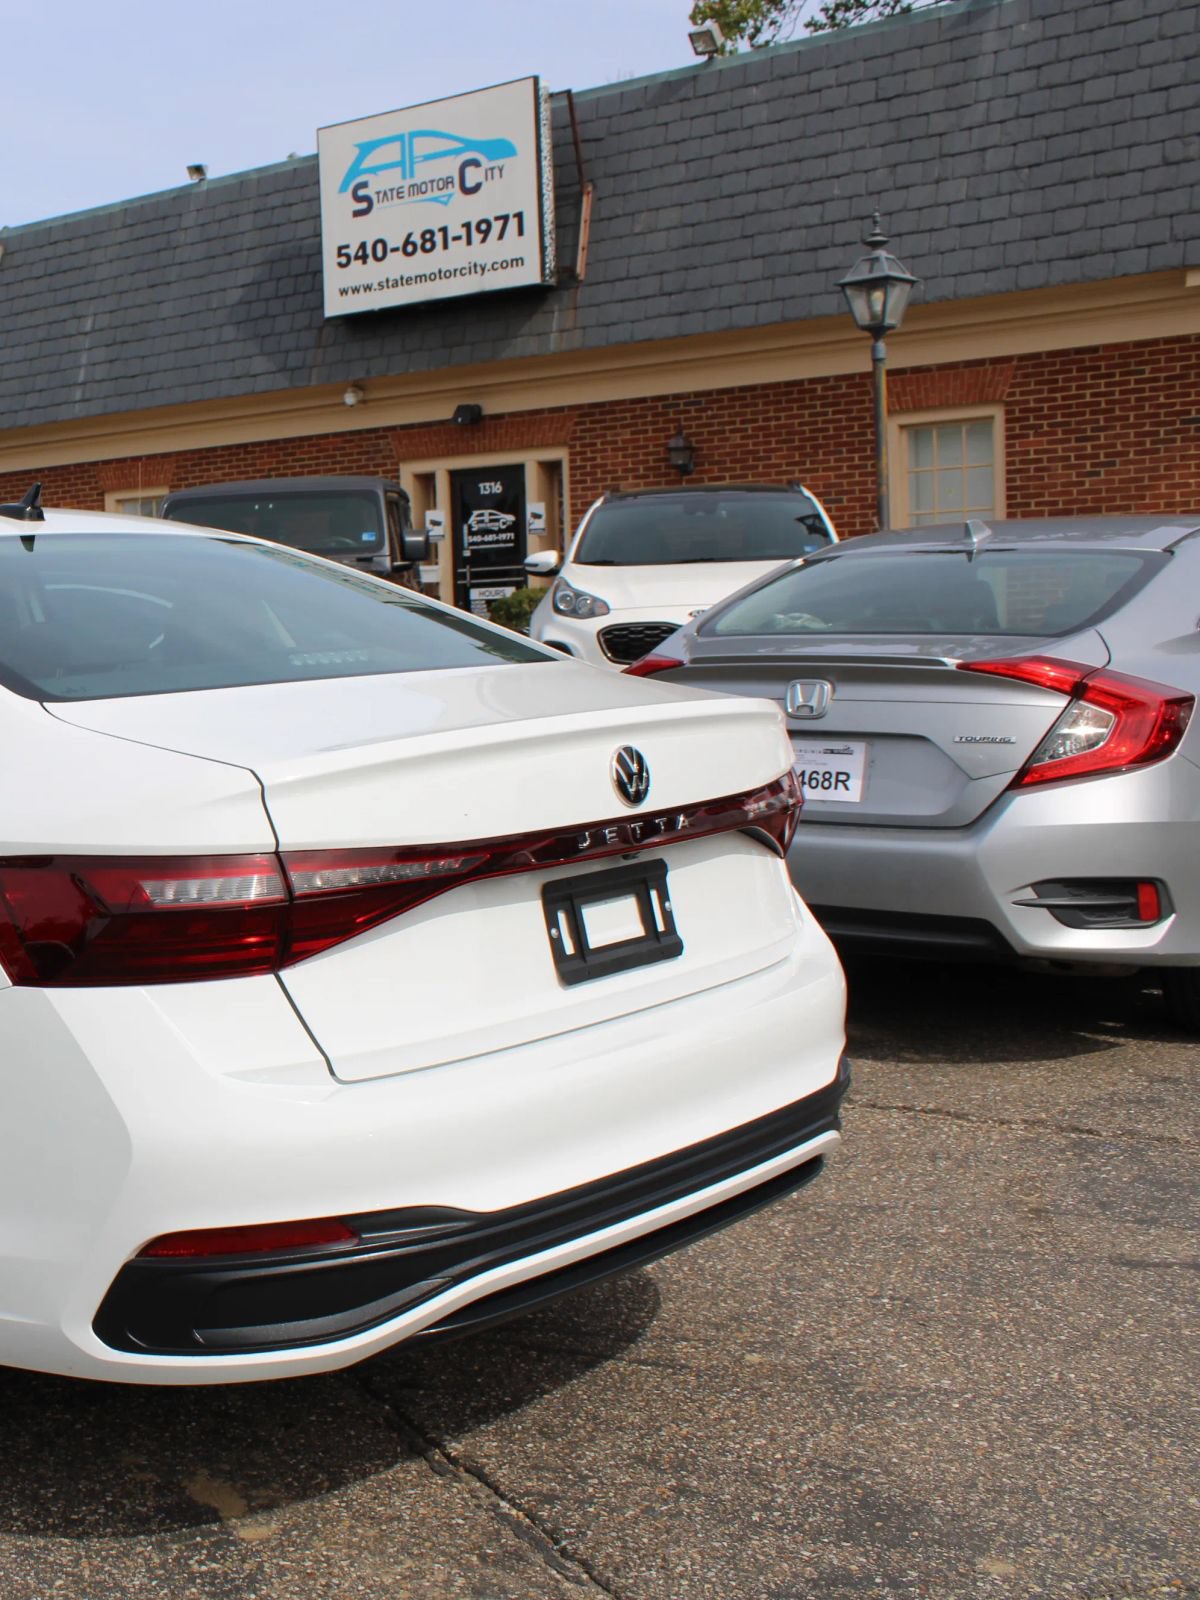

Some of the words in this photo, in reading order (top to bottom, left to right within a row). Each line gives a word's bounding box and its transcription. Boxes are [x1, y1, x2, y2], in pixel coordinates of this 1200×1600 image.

[351, 180, 405, 218] STATE
[407, 176, 455, 198] MOTOR
[458, 157, 505, 195] CITY
[336, 211, 525, 269] 540-681-1971
[338, 256, 525, 297] www.statemotorcity.com
[478, 481, 503, 495] 1316
[478, 589, 506, 598] HOURS
[959, 735, 1013, 743] TOURING
[578, 813, 690, 850] JETTA
